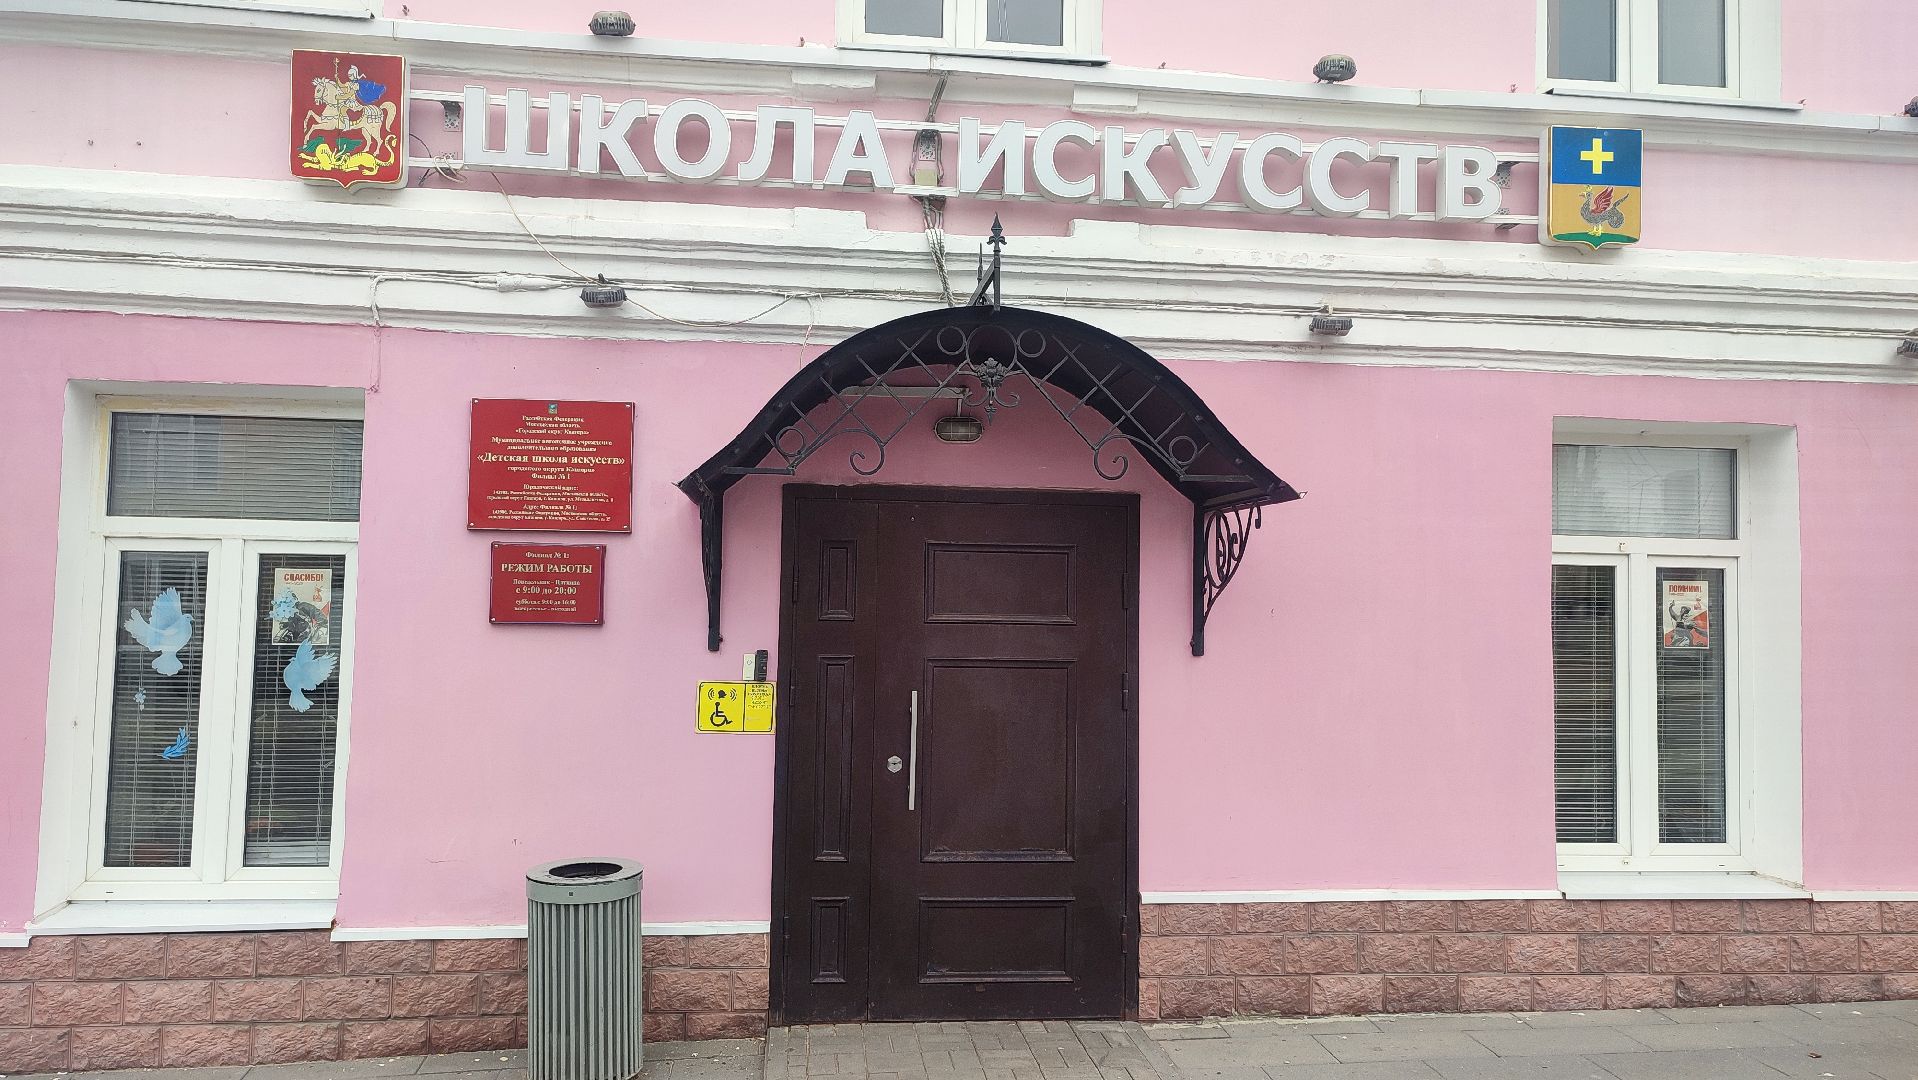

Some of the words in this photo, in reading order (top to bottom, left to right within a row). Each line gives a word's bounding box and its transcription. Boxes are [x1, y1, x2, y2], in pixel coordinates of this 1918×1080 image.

[462, 85, 895, 189] ШКОЛА
[958, 116, 1502, 222] ИСКУССТВ
[477, 453, 528, 463] «Детская
[532, 455, 568, 464] школа
[571, 456, 625, 466] искусств»
[501, 564, 544, 573] РЕЖИМ
[546, 564, 593, 574] РАБОТЫ
[284, 573, 324, 581] СПАСИБО!
[523, 586, 540, 594] 9:00
[554, 587, 577, 595] 20:00
[1668, 585, 1701, 593] ПОМНИМ!
